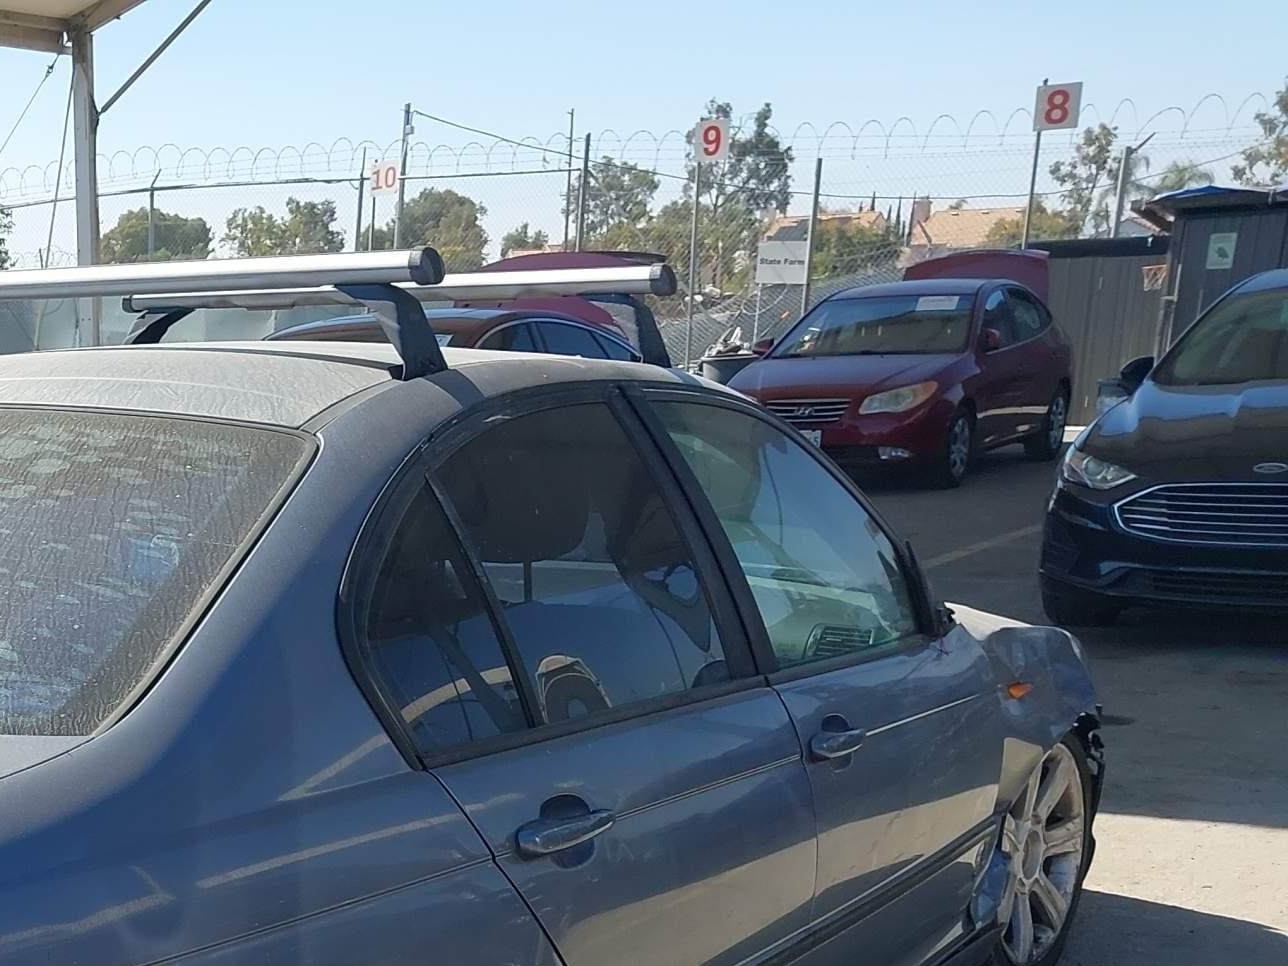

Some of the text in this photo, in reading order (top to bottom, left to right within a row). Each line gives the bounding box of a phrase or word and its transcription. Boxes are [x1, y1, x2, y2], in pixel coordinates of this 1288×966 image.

[1045, 89, 1070, 125] 8
[703, 125, 721, 156] 9
[371, 166, 396, 191] 10
